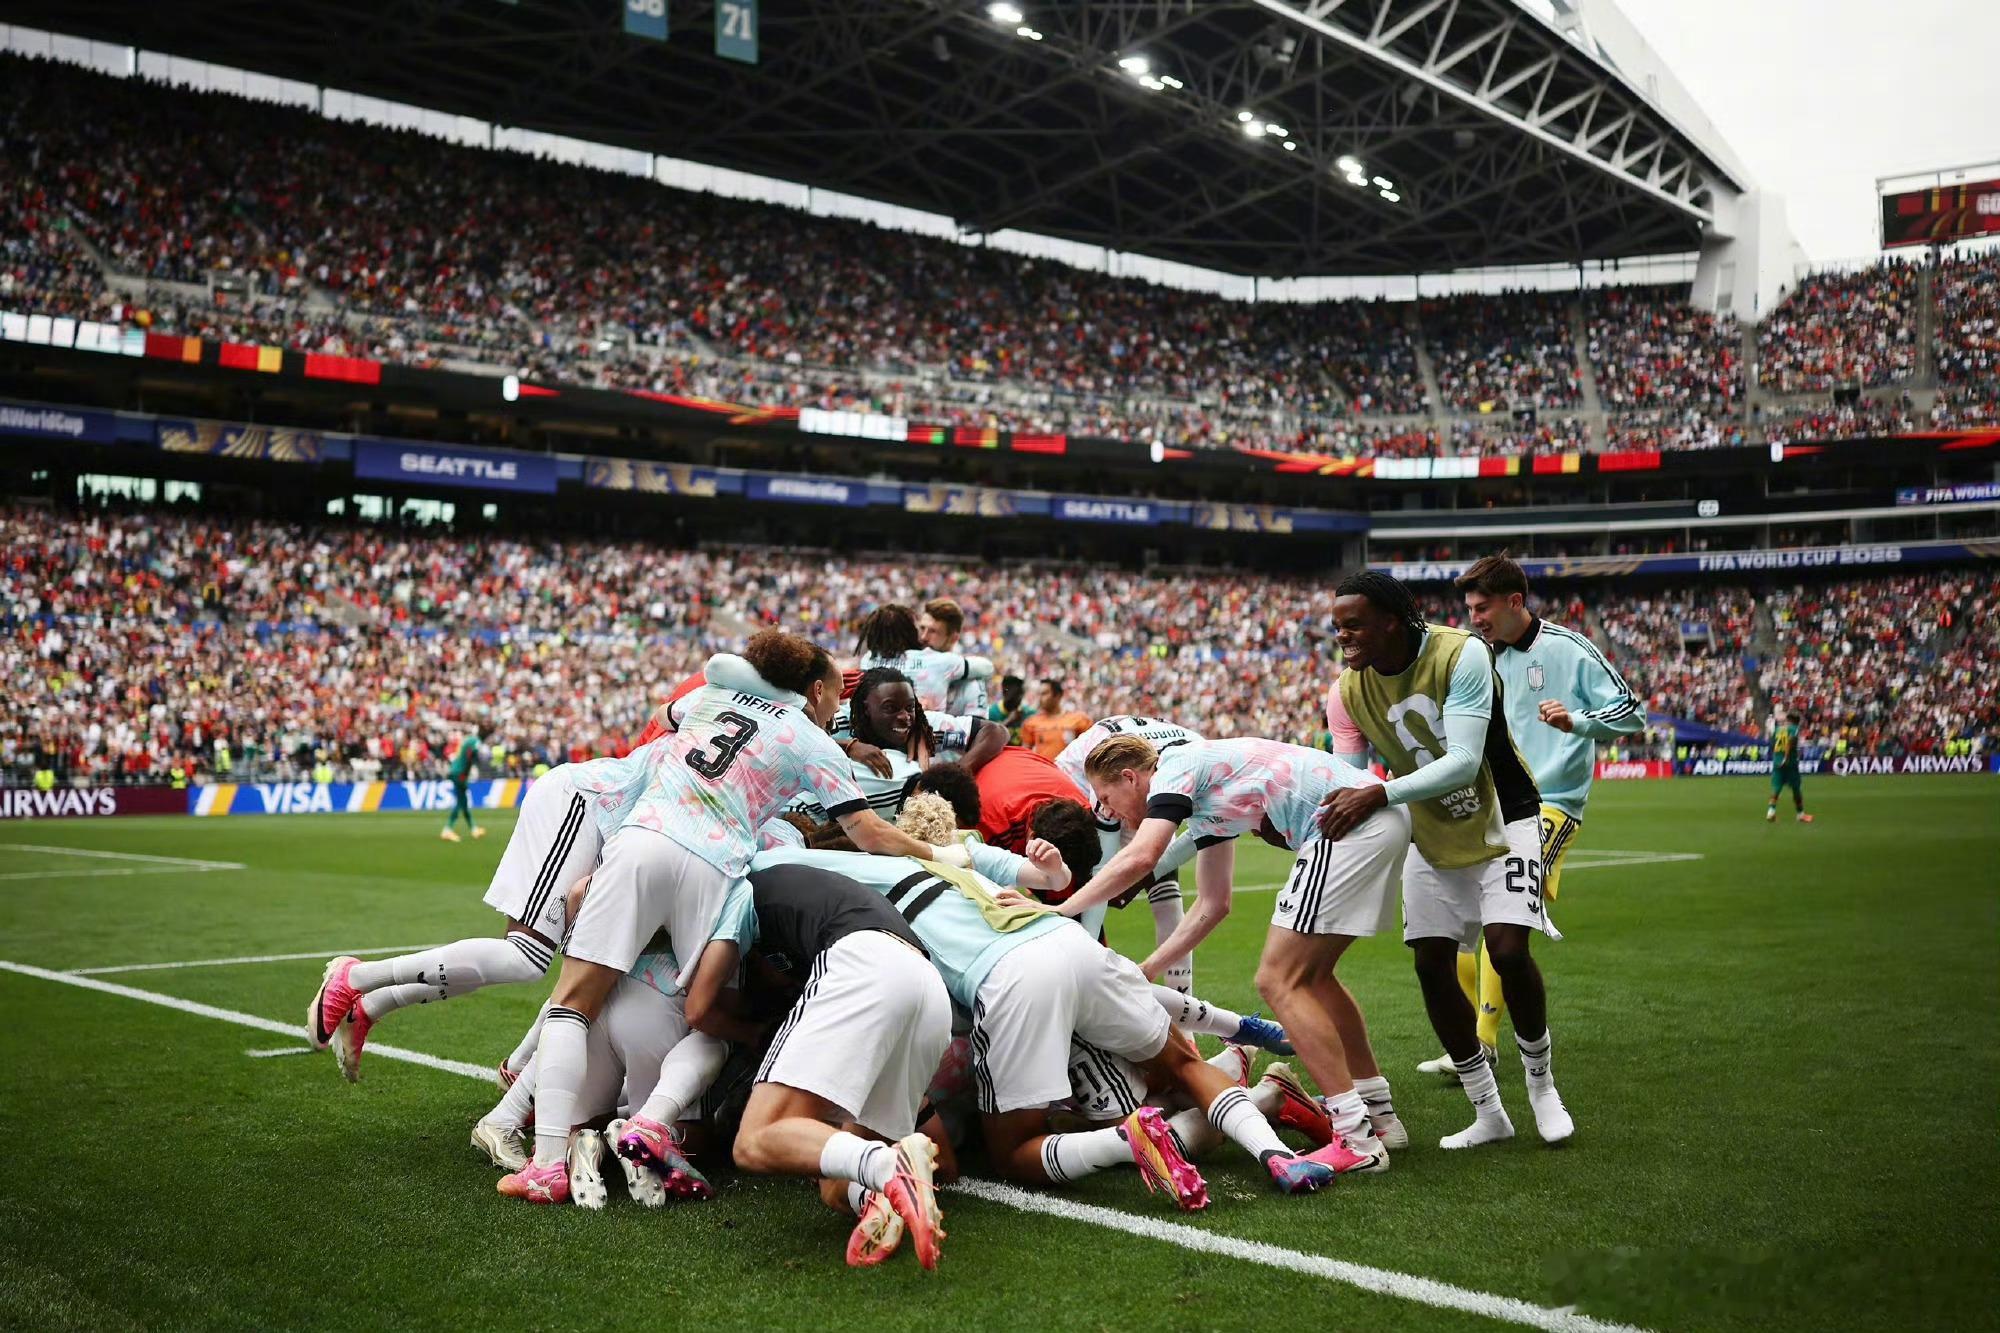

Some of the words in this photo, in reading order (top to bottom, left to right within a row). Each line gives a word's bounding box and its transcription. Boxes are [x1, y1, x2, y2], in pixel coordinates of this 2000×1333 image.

[721, 4, 753, 40] 71
[400, 453, 517, 480] SEATTLE
[1925, 487, 1953, 502] FIFA
[1064, 500, 1149, 521] SEATTLE
[1392, 563, 1473, 581] SEATT
[1699, 553, 1735, 571] FIFA
[1738, 551, 1799, 569] WORLD
[1802, 549, 1837, 566] CUP
[1840, 547, 1902, 564] 2026
[684, 710, 760, 783] 3
[1832, 755, 1894, 776] QATAR
[1901, 754, 1983, 774] AIRWAYS
[0, 787, 116, 817] IRWAYS
[254, 782, 333, 814] VISA
[1291, 858, 1308, 894] 7
[1505, 857, 1540, 898] 25
